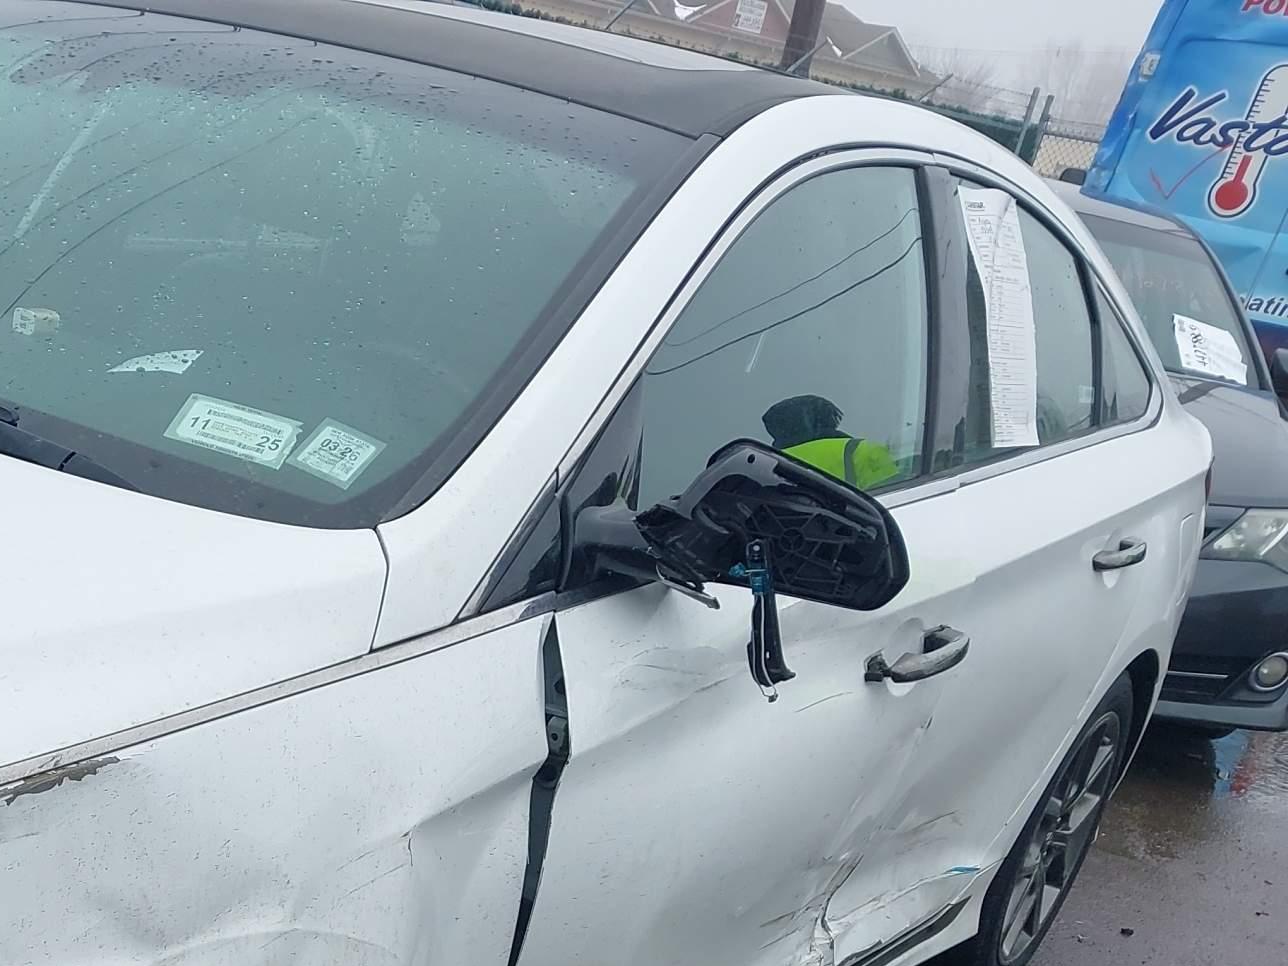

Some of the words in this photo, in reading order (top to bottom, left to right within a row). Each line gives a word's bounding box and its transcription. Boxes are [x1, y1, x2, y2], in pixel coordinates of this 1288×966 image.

[190, 415, 212, 431] 11
[256, 435, 283, 452] 25
[320, 438, 340, 451] 03
